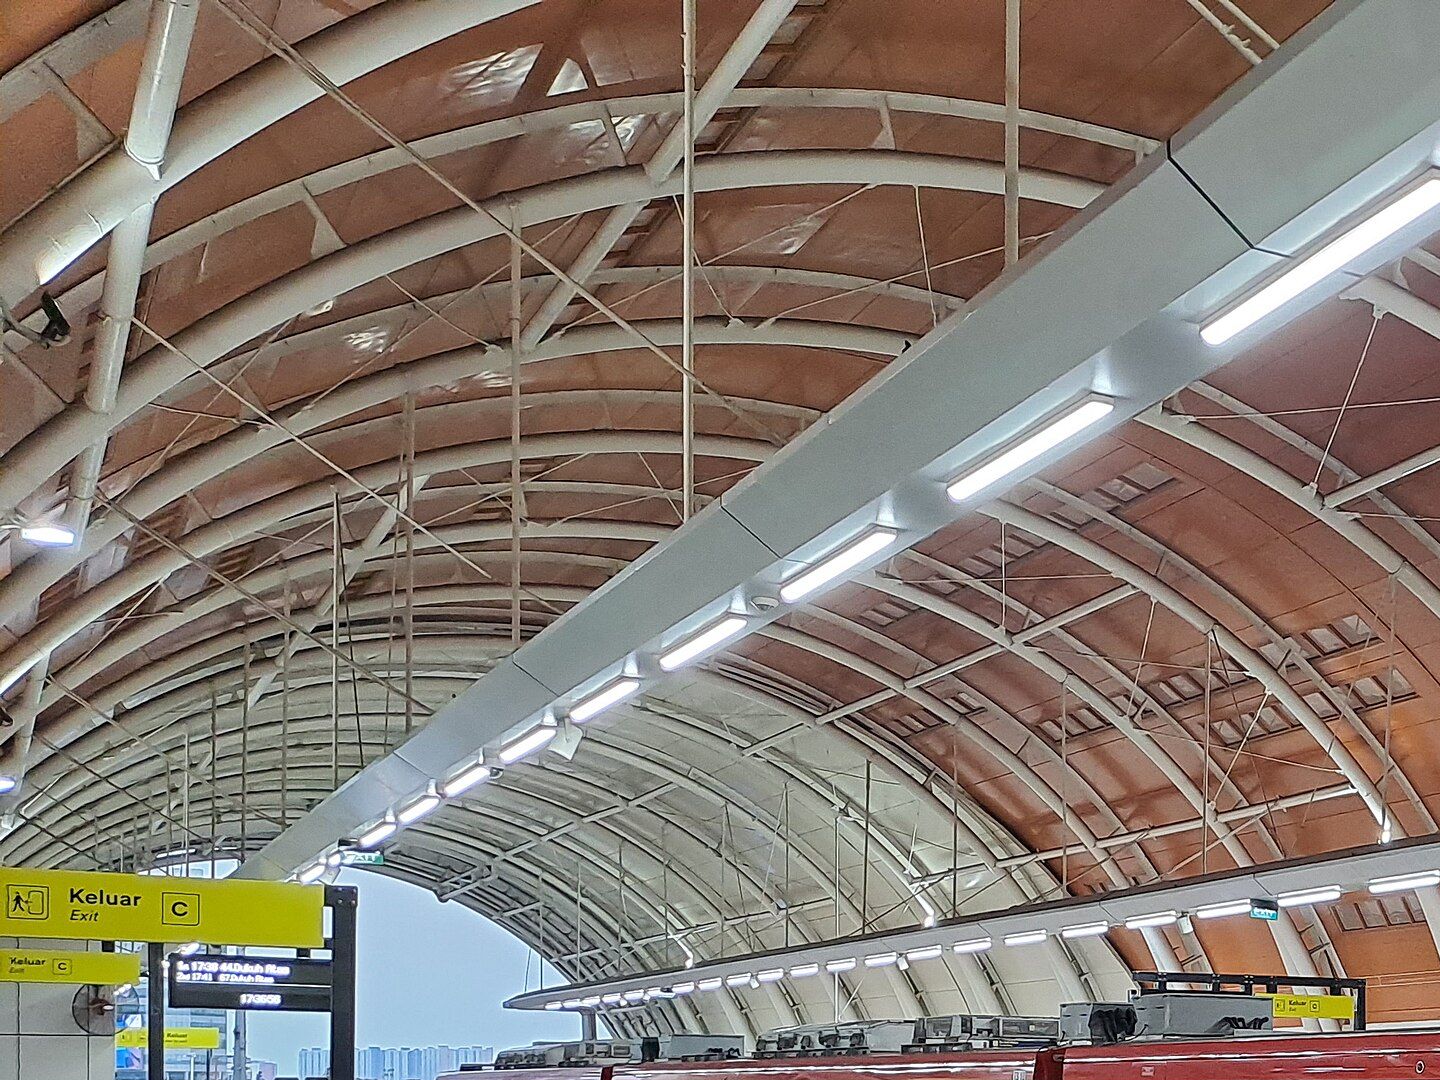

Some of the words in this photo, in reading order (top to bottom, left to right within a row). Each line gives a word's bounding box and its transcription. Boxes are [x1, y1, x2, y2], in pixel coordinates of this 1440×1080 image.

[69, 887, 142, 907] Keluar
[171, 901, 188, 917] C
[69, 909, 99, 922] Exit
[9, 956, 46, 966] Keluar
[58, 962, 67, 970] C
